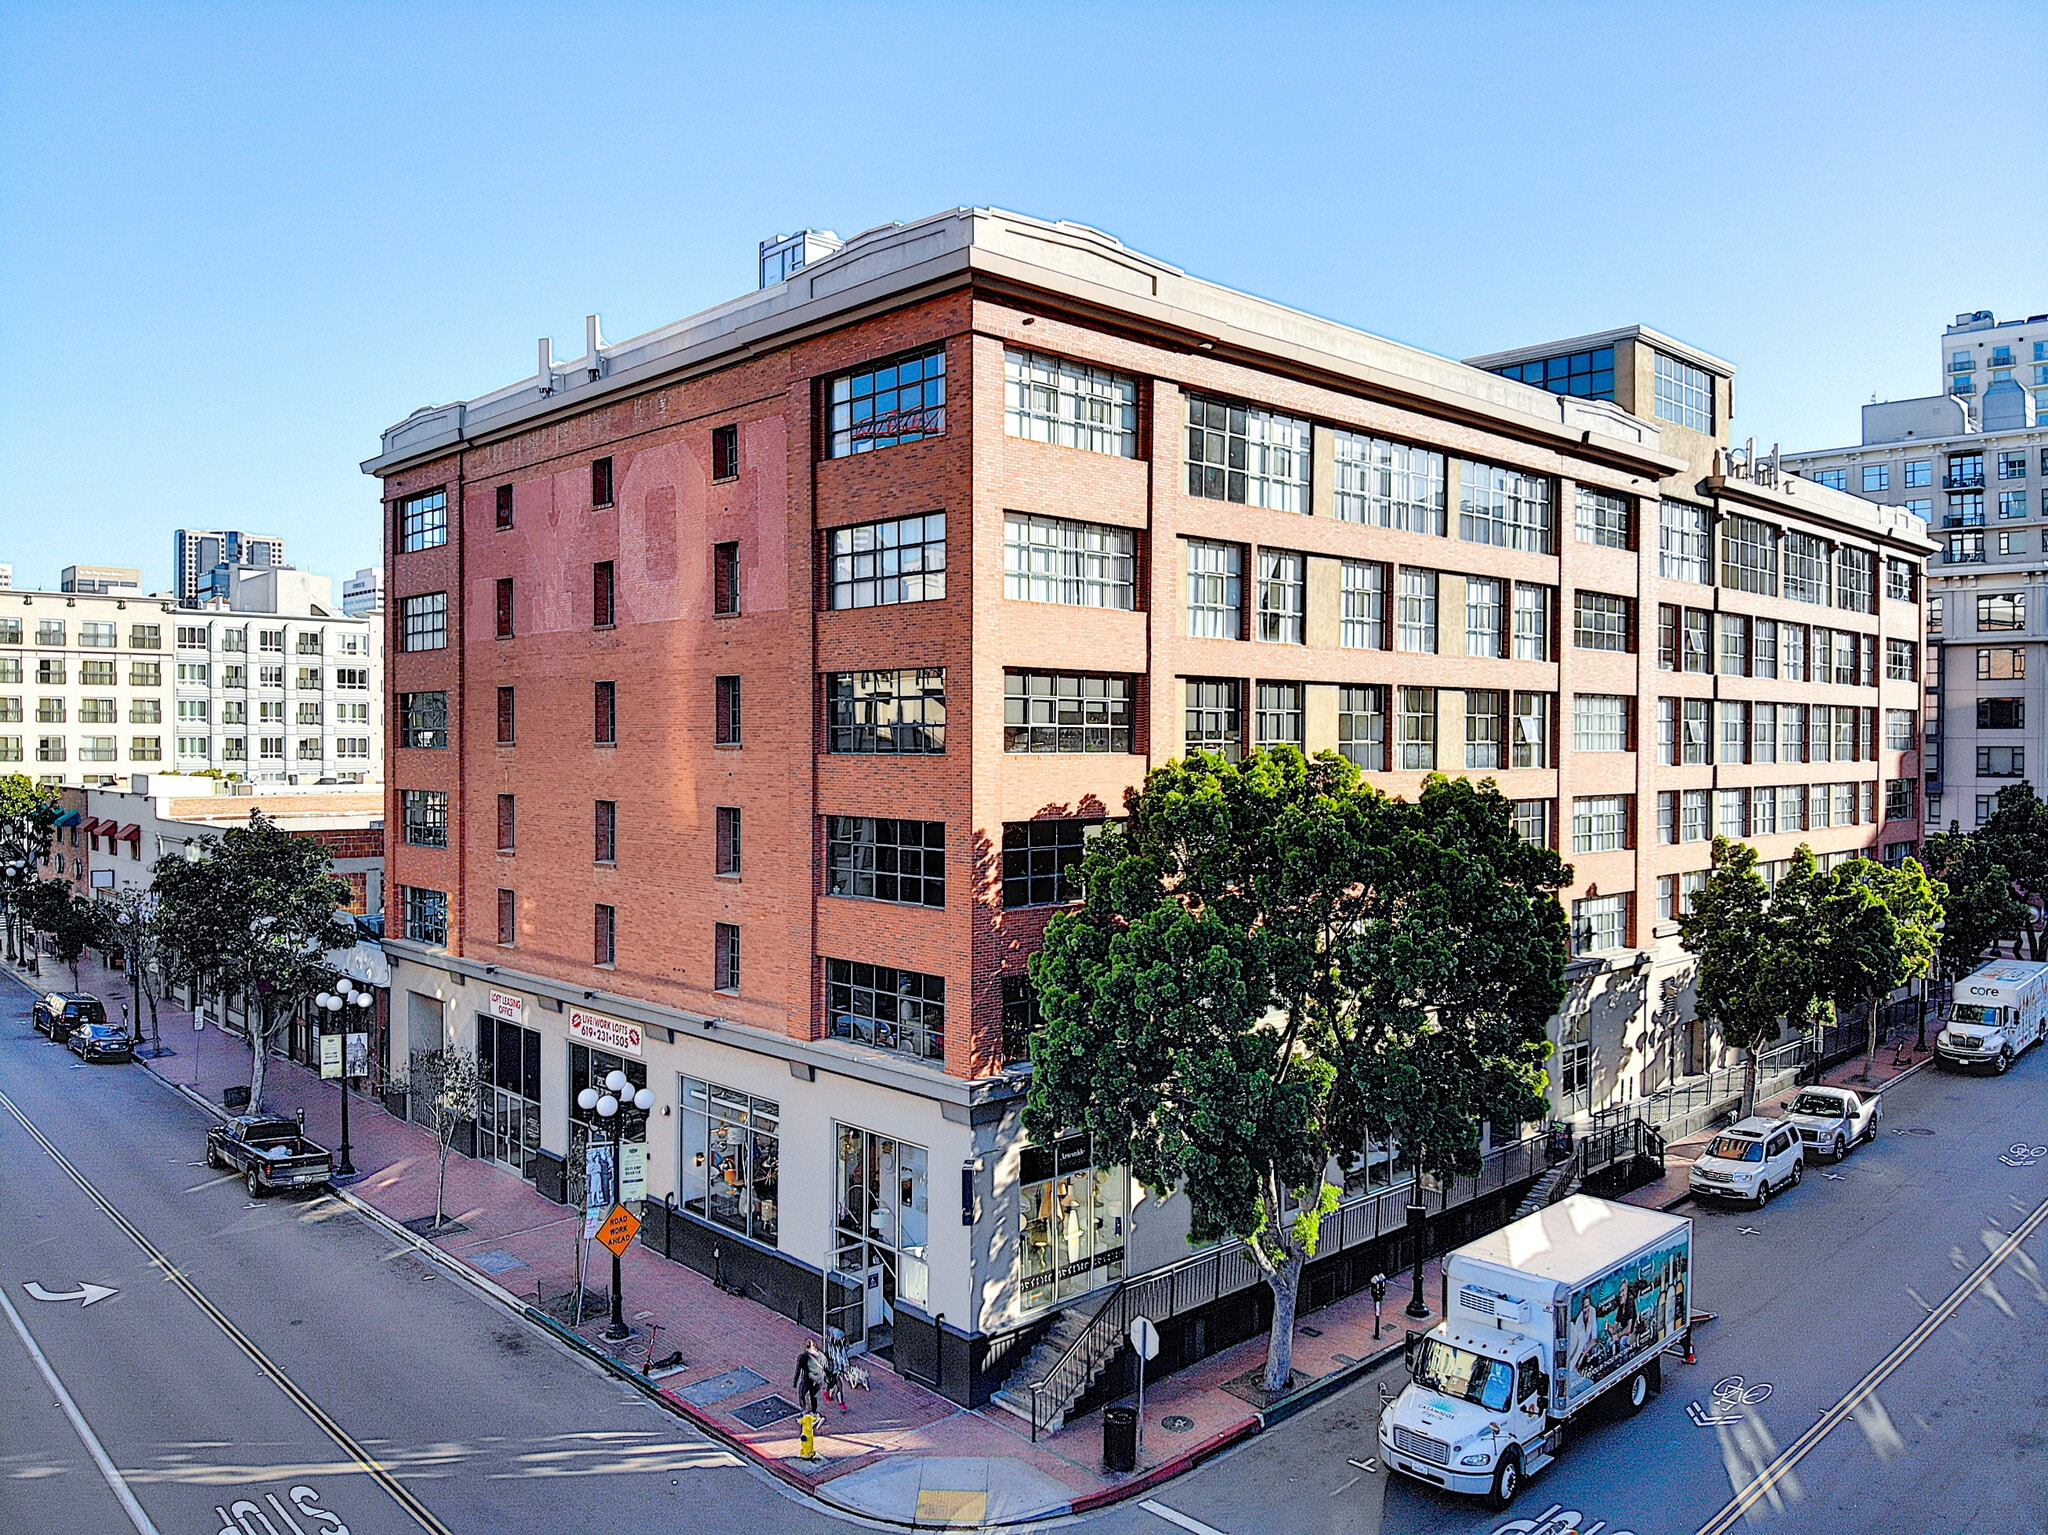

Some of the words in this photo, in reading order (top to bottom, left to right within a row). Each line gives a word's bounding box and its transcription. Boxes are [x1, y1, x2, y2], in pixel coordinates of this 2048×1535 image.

[1970, 986, 1999, 997] core
[491, 993, 502, 1003] LOFT
[502, 996, 521, 1009] LEASING
[498, 1005, 513, 1017] OFFICE
[612, 1022, 628, 1036] LOFTS
[610, 1215, 628, 1225] ROAD
[610, 1226, 628, 1235] WORK
[608, 1234, 631, 1245] AHEAD
[1418, 1403, 1455, 1420] CASAMIGOS
